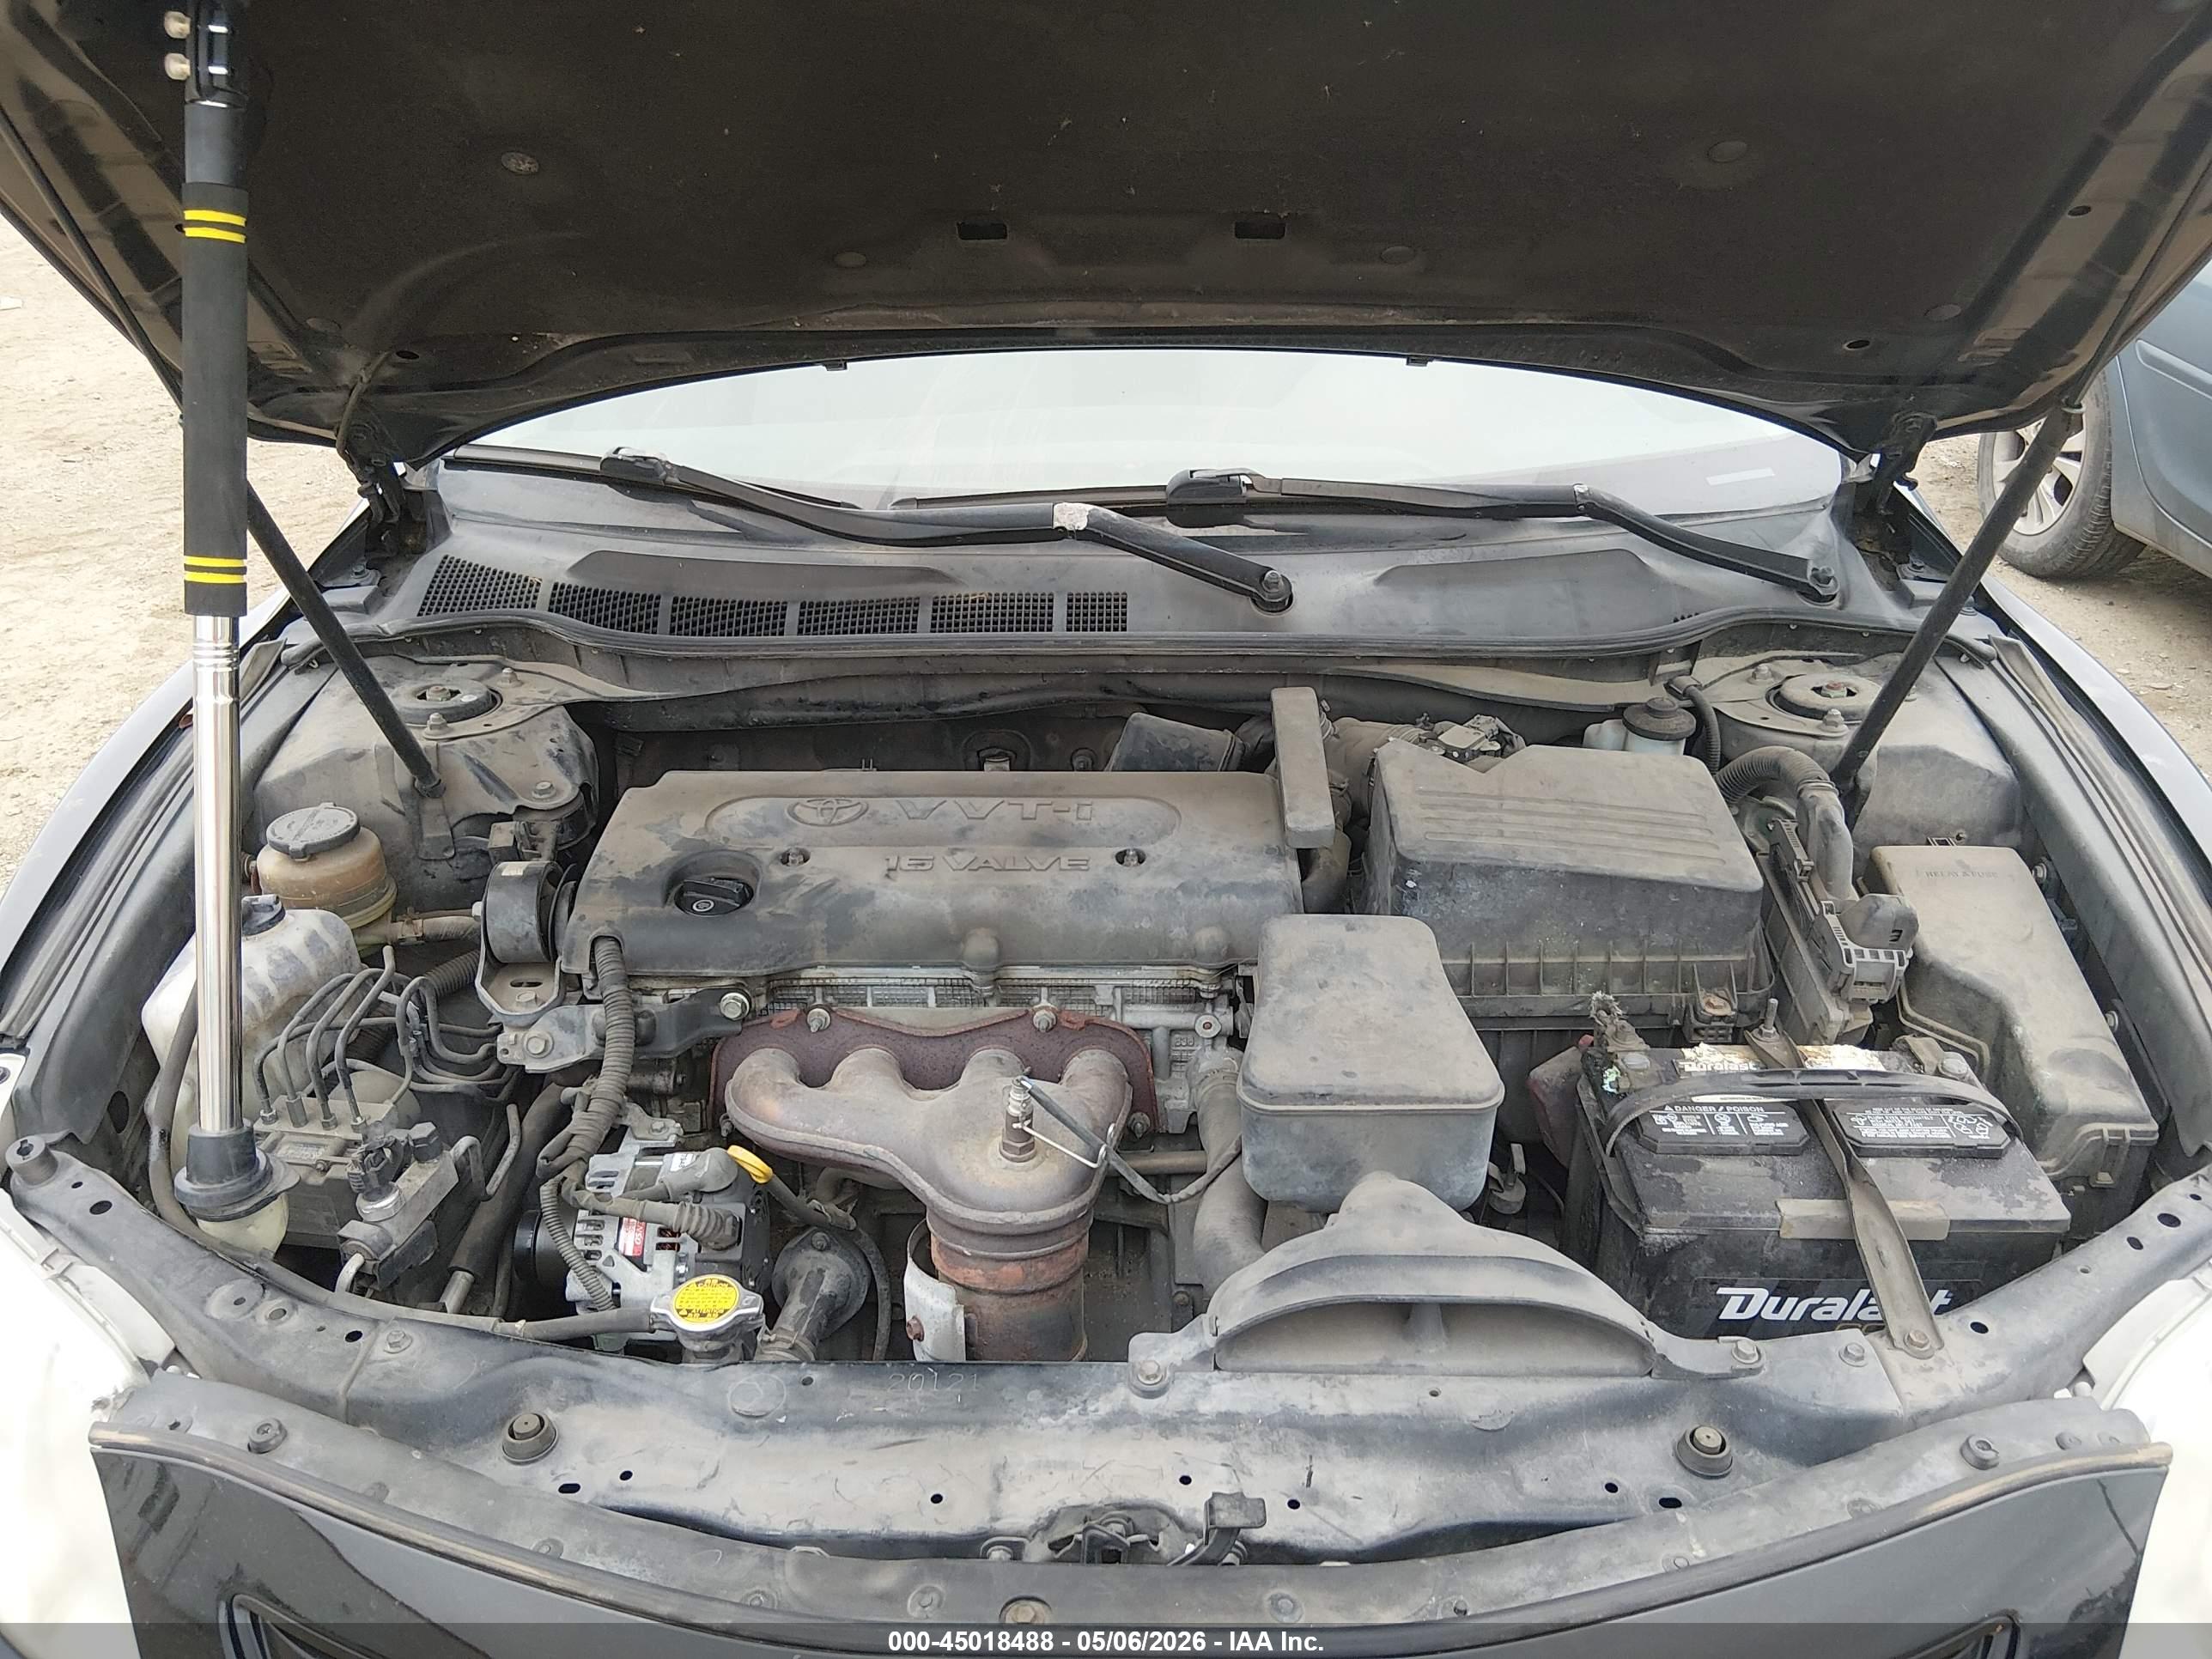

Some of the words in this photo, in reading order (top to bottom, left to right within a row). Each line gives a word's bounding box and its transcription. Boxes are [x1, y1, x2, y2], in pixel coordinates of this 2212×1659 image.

[896, 799, 1093, 821] VVT-i
[942, 856, 1091, 872] VALVE
[1717, 1286, 1953, 1322] Duralat
